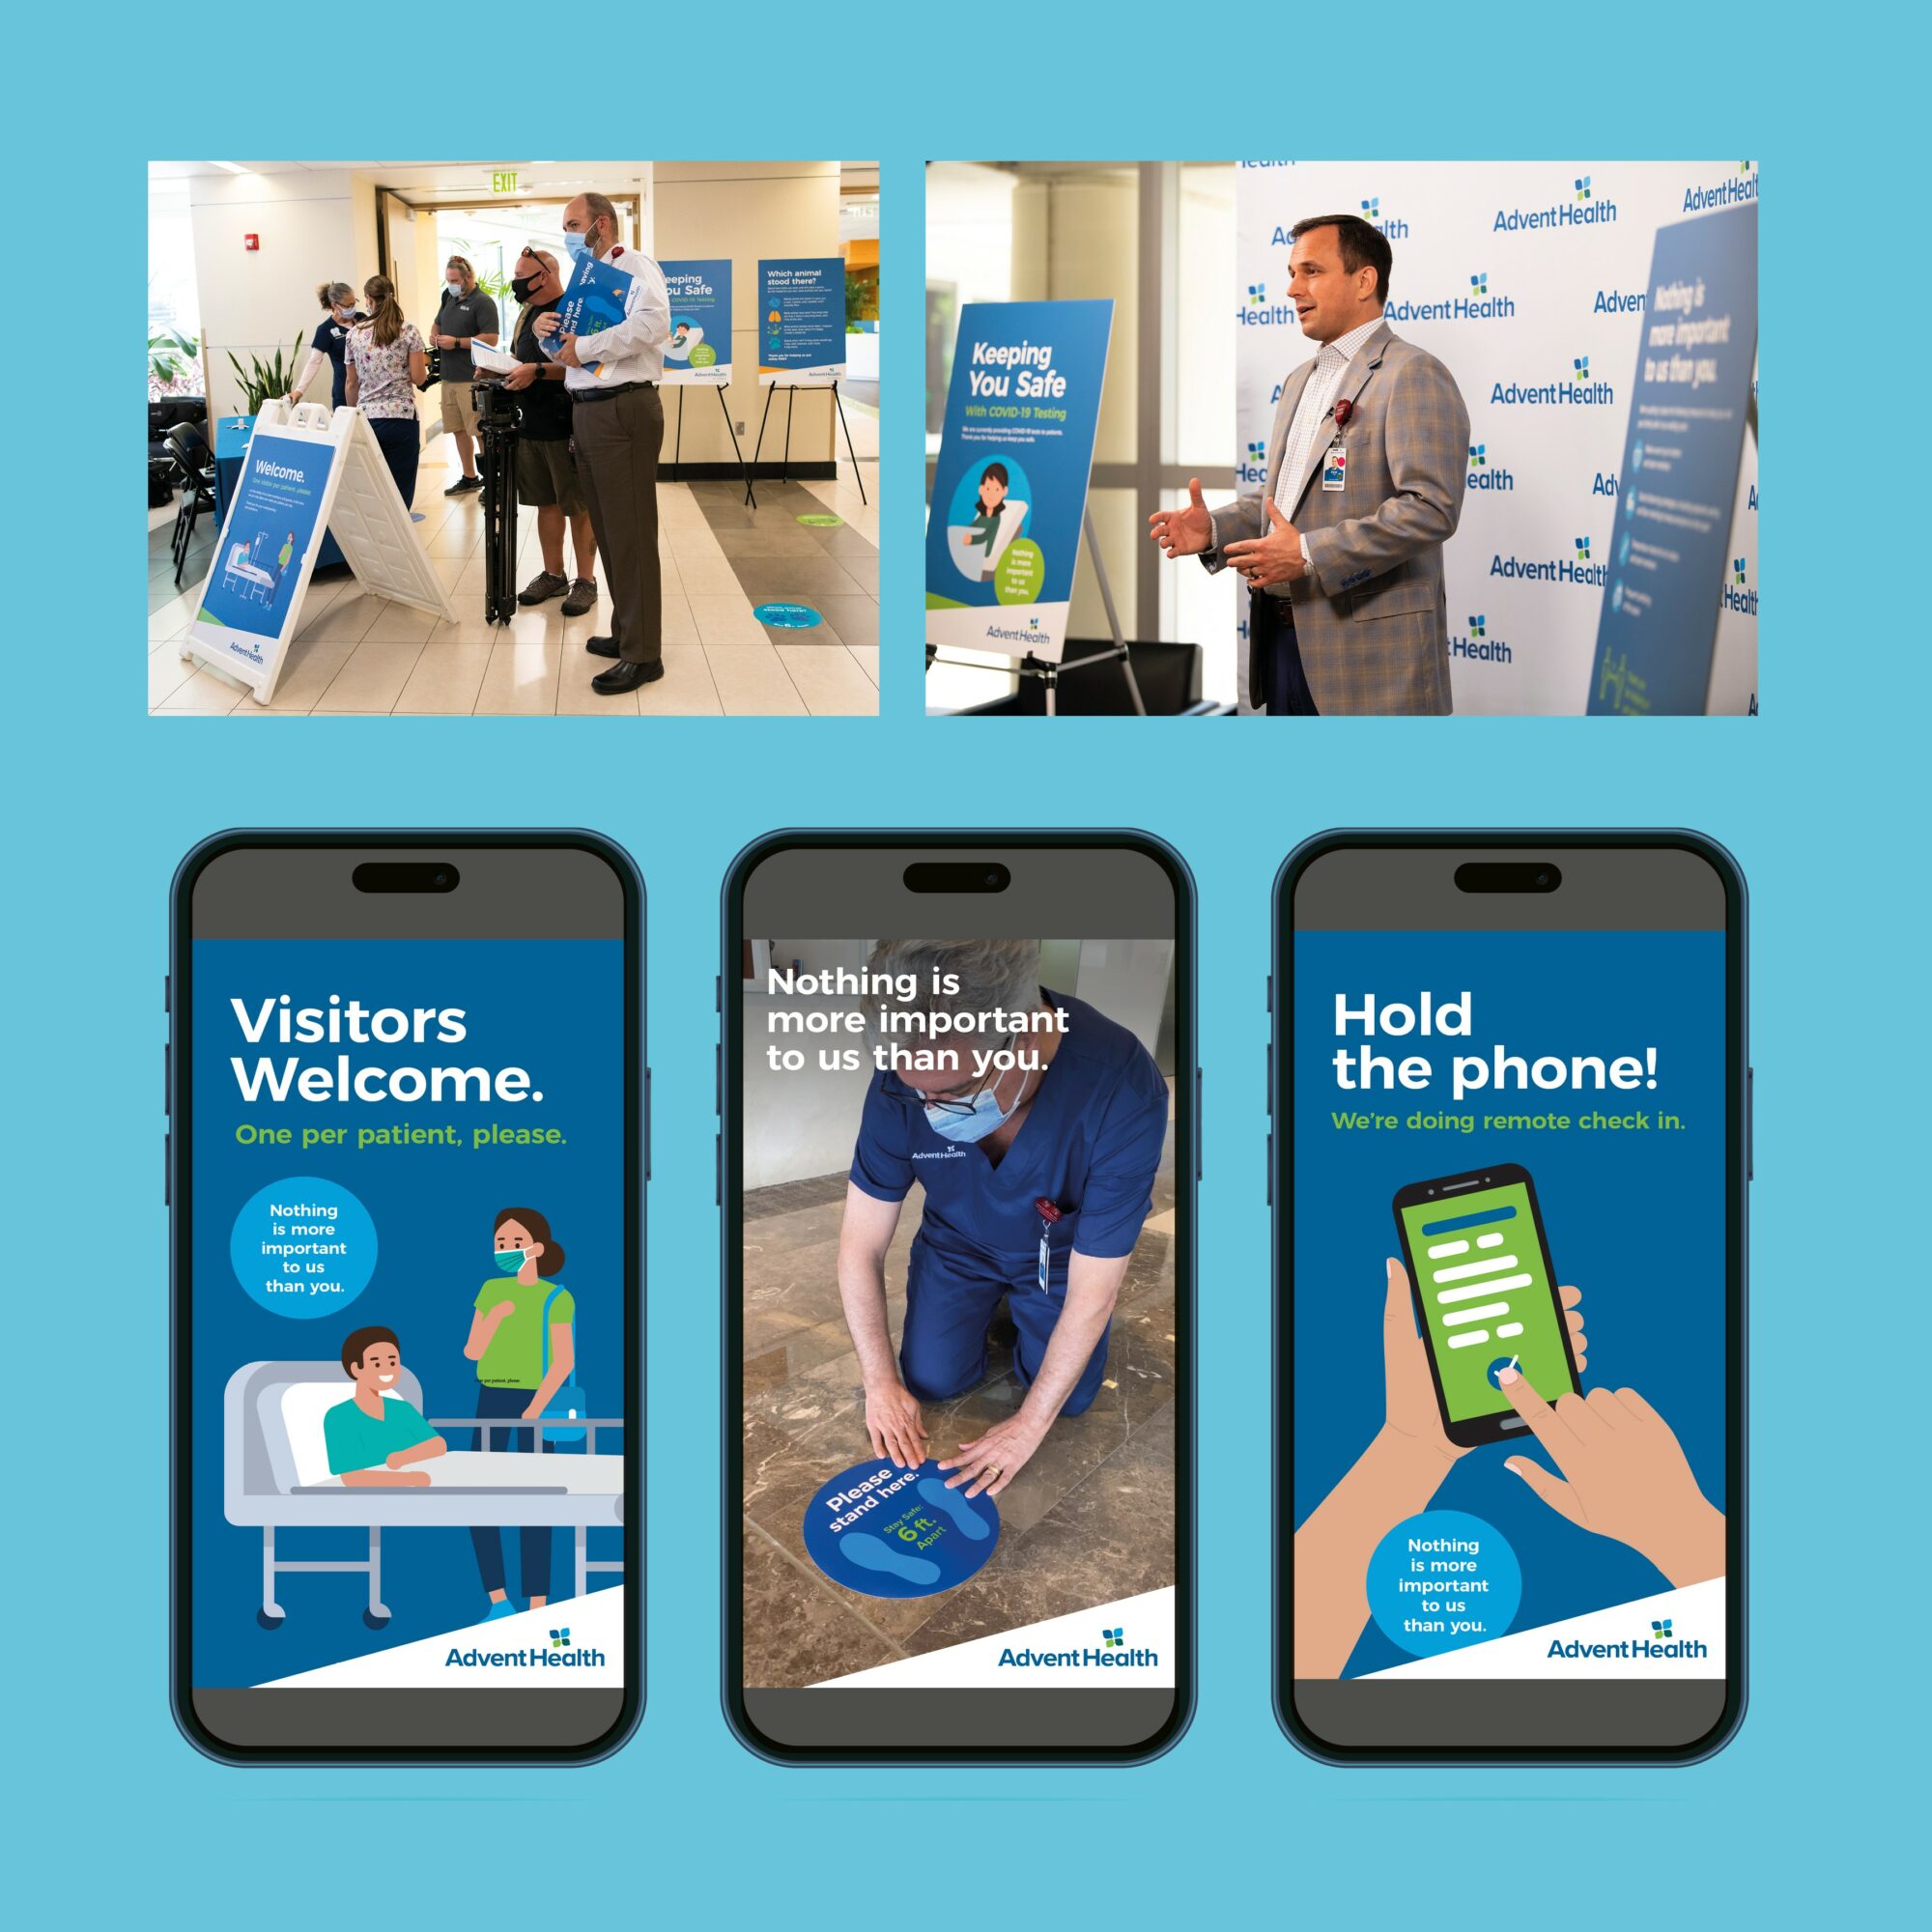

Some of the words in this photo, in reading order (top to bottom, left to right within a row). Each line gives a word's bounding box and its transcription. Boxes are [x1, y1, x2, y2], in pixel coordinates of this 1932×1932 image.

[494, 173, 518, 192] EXIT
[666, 273, 702, 286] eeping
[667, 287, 681, 296] ou
[685, 284, 713, 296] Safe
[1594, 290, 1648, 313] Adven
[1654, 279, 1693, 315] Nothing
[1694, 276, 1706, 307] is
[559, 300, 575, 334] Please
[1648, 324, 1675, 347] more
[1675, 314, 1732, 352] important
[972, 340, 1052, 370] Keeping
[1644, 356, 1656, 383] to
[1656, 359, 1668, 383] us
[1668, 353, 1693, 383] than
[969, 370, 1010, 397] You
[1015, 369, 1066, 398] Safe
[966, 405, 986, 417] With
[989, 406, 1032, 418] COVID-19
[1034, 407, 1066, 422] Testing
[255, 459, 305, 483] Welcome.
[1465, 469, 1514, 491] ealth
[767, 966, 918, 1002] Nothing
[932, 966, 960, 995] is
[230, 994, 467, 1043] Visitors
[767, 1009, 866, 1033] more
[880, 1005, 1069, 1039] important
[1335, 991, 1471, 1037] Hold
[767, 1044, 805, 1070] to
[818, 1048, 860, 1070] us
[873, 1042, 959, 1070] than
[971, 1048, 1048, 1077] you.
[230, 1055, 544, 1102] Welcome.
[1332, 1044, 1433, 1090] the
[1453, 1044, 1658, 1100] phone!
[1406, 1111, 1474, 1134] doing
[1484, 1113, 1571, 1129] remote
[1578, 1111, 1650, 1129] check
[1658, 1111, 1686, 1129] in.
[235, 1123, 293, 1145] One
[302, 1128, 348, 1150] per
[357, 1122, 463, 1150] patient,
[473, 1123, 567, 1150] please.
[912, 1151, 966, 1159] AdventHealth
[270, 1204, 338, 1220] Nothing
[272, 1222, 286, 1236] is
[291, 1225, 335, 1236] more
[262, 1241, 347, 1258] important
[282, 1262, 300, 1273] to
[305, 1263, 325, 1273] us
[266, 1279, 304, 1293] than
[310, 1282, 345, 1295] you.
[825, 1468, 893, 1513] Please
[829, 1496, 880, 1533] stand
[876, 1472, 920, 1499] here.
[883, 1518, 904, 1535] Stay
[897, 1526, 918, 1542] 6
[914, 1517, 938, 1531] ft.
[916, 1525, 947, 1551] Apart
[1408, 1538, 1479, 1555] Nothing
[1411, 1558, 1425, 1572] is
[1431, 1561, 1477, 1572] more
[1399, 1577, 1489, 1595] important
[1421, 1600, 1440, 1612] to
[1445, 1601, 1465, 1612] us
[1404, 1618, 1445, 1633] than
[1450, 1621, 1487, 1635] you.
[445, 1649, 606, 1667] AdventHealth
[999, 1649, 1158, 1667] AdventHealth
[1547, 1640, 1708, 1659] AdventHealth
